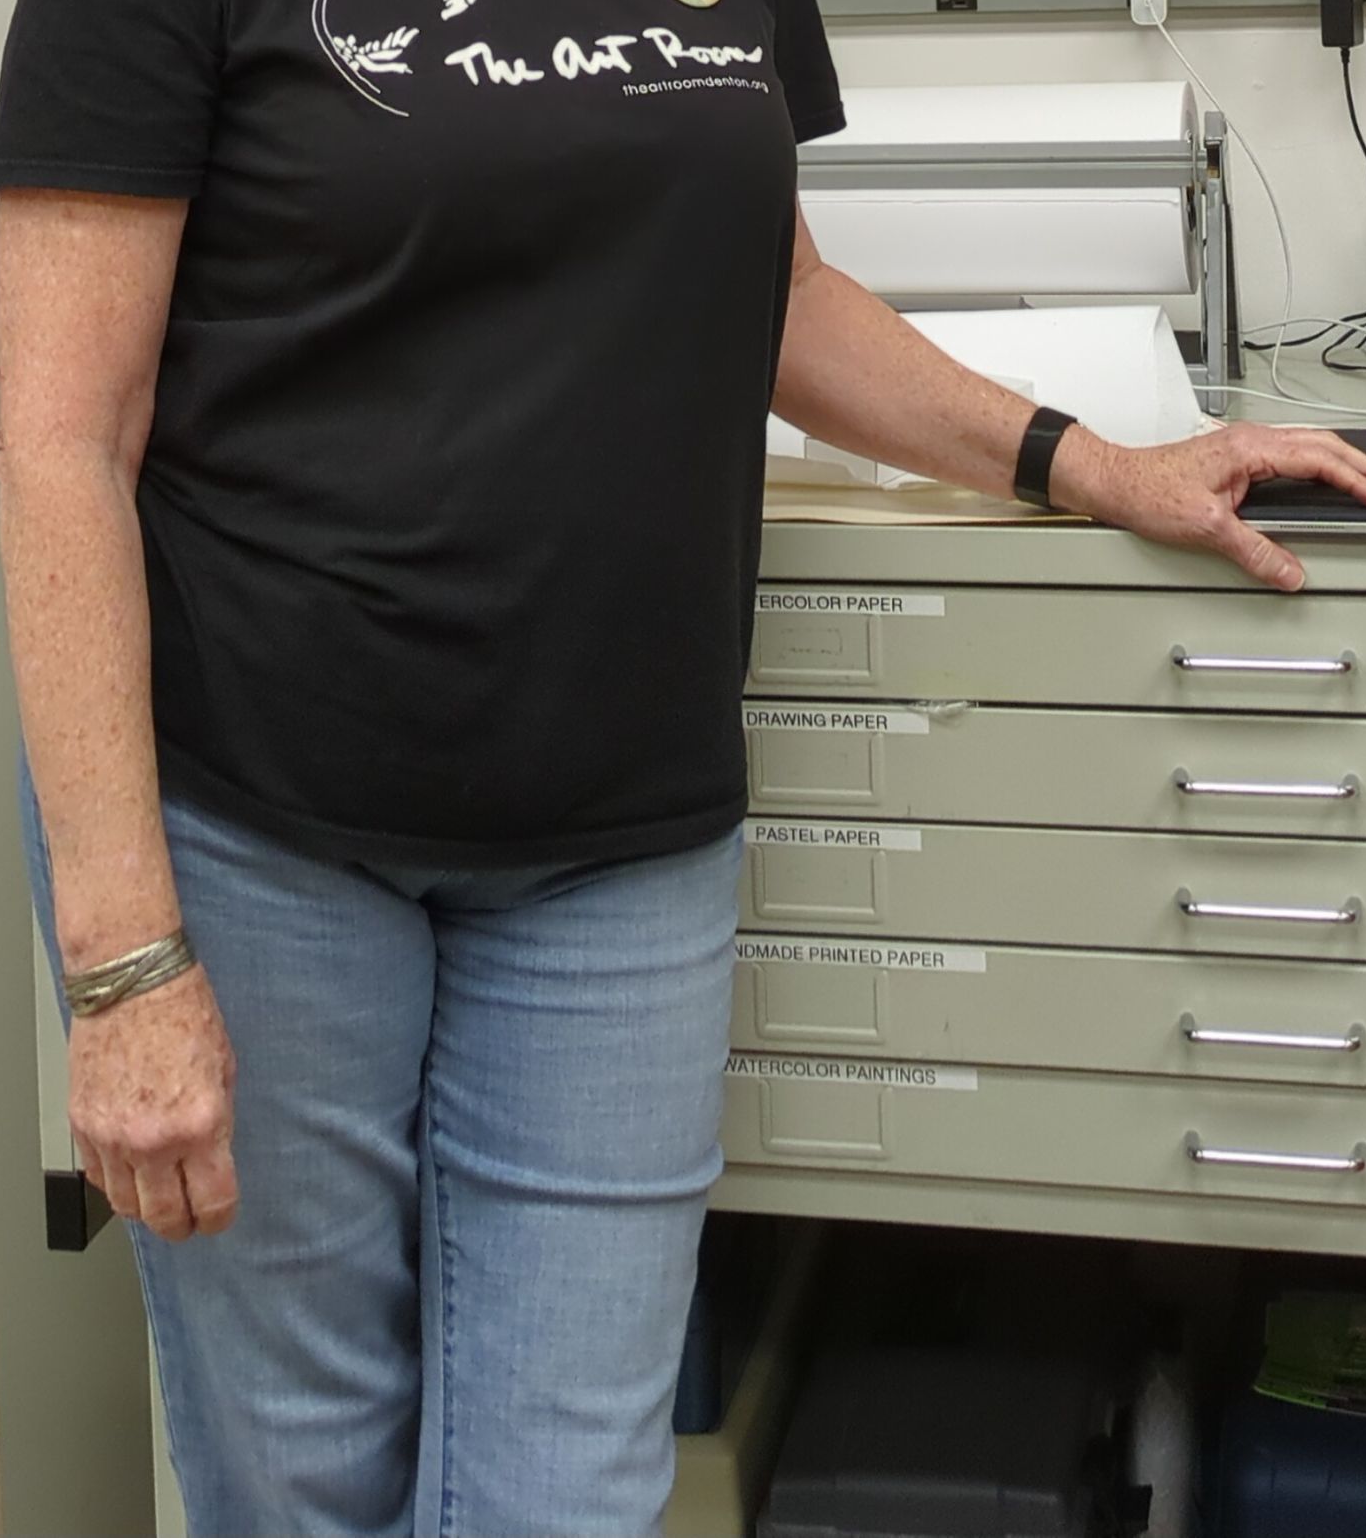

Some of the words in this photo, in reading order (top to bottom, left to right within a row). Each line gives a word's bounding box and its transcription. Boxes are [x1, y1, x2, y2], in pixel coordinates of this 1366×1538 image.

[445, 41, 544, 86] The
[552, 34, 638, 80] Art
[642, 26, 764, 68] Room
[622, 77, 770, 97] theartroomdenton.org
[757, 594, 842, 613] ERCOLOR
[846, 595, 904, 613] PAPER
[746, 711, 827, 729] DRAWING
[830, 713, 889, 731] PAPER
[755, 826, 819, 844] PASTEL
[823, 828, 881, 846] PAPER
[735, 943, 804, 962] NDMADE
[808, 946, 883, 965] PRINTED
[887, 950, 945, 968] PAPER
[724, 1057, 841, 1079] WATERCOLOR
[845, 1064, 936, 1086] PAINTINGS
